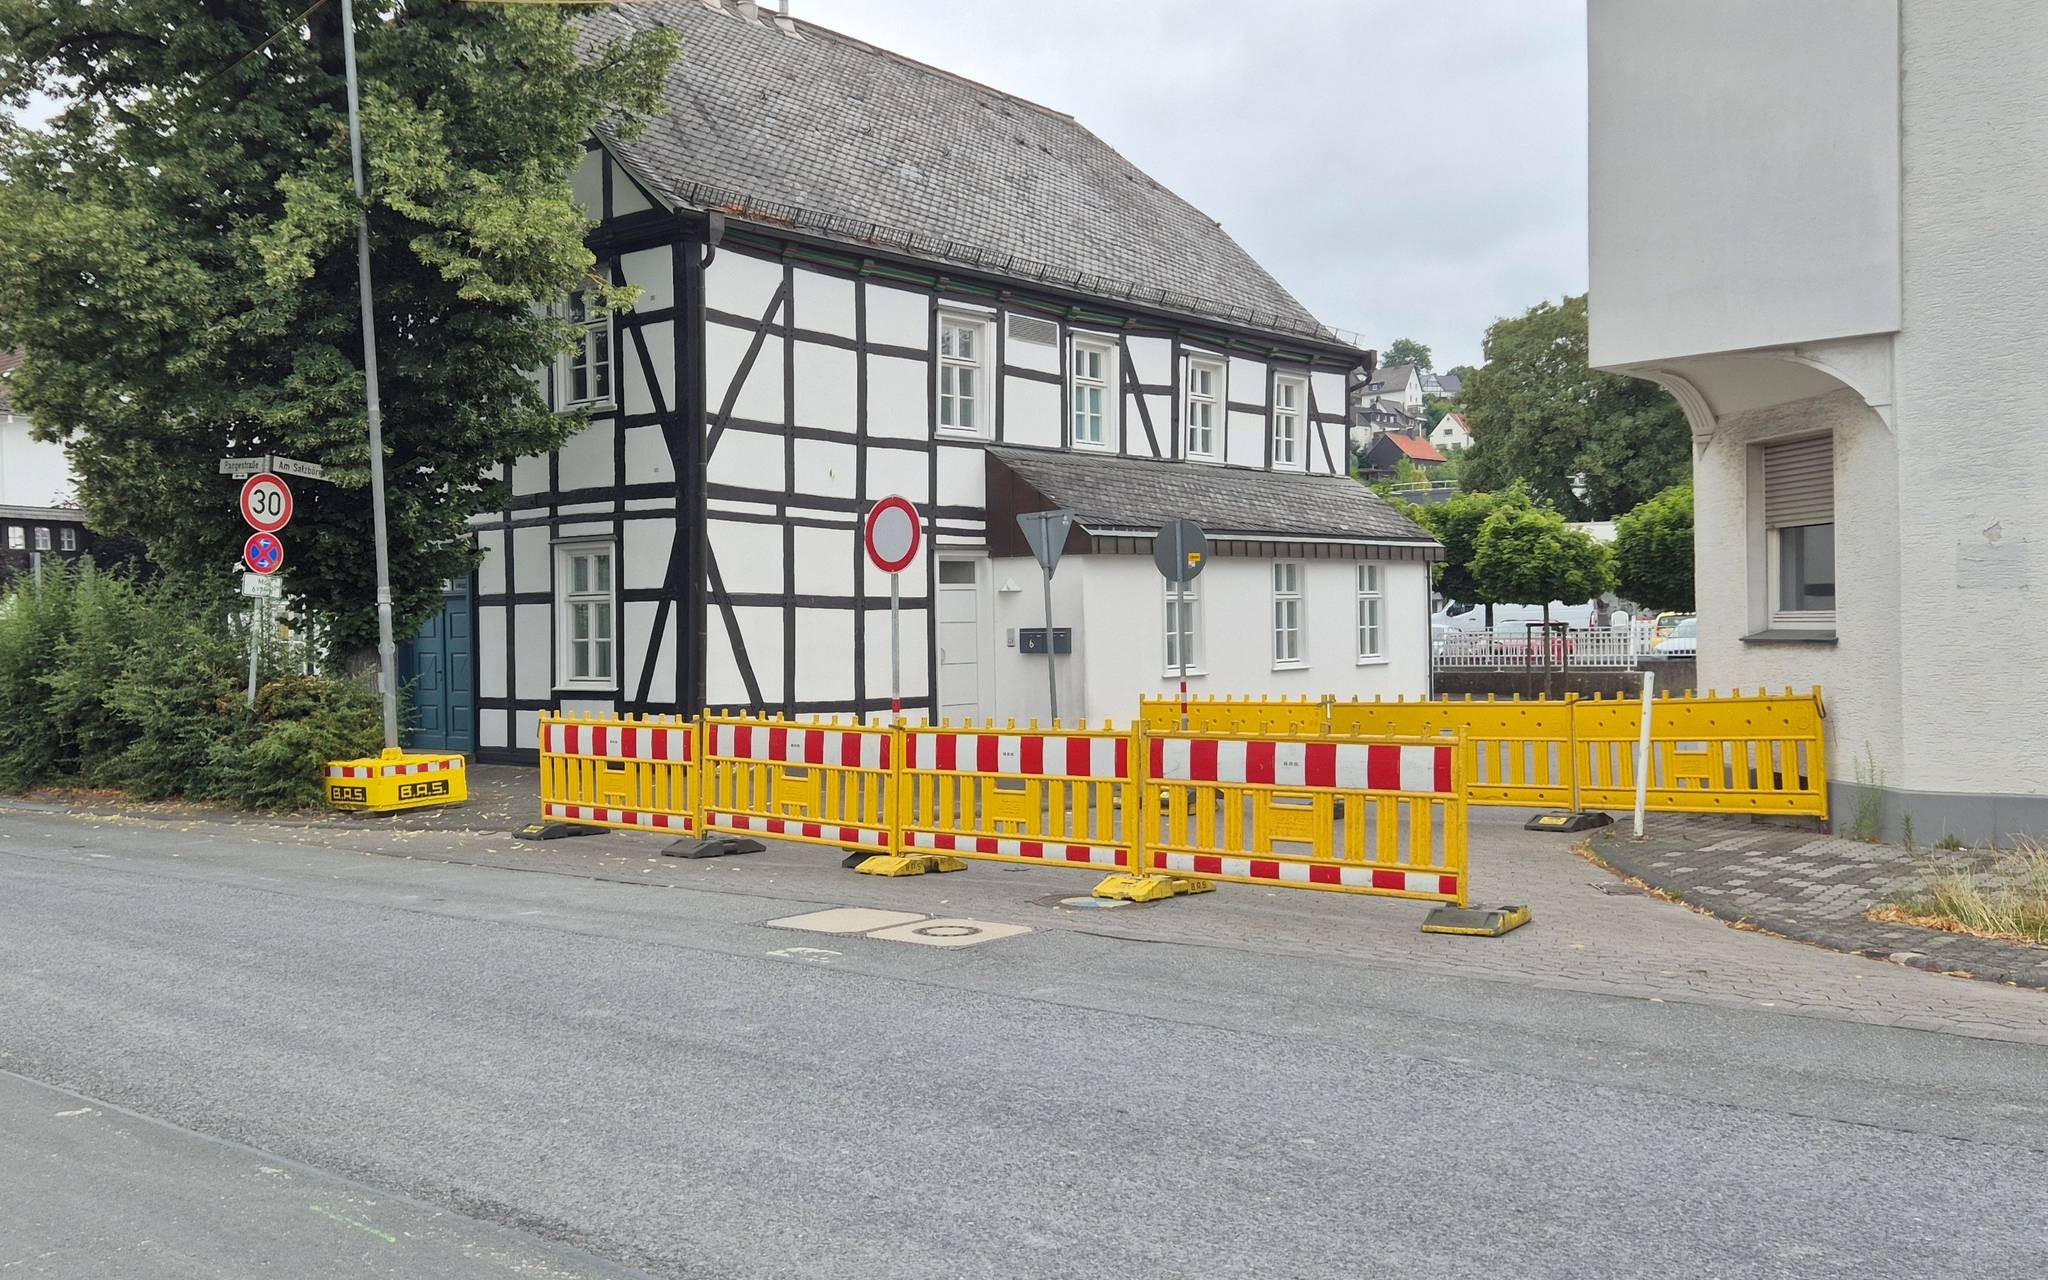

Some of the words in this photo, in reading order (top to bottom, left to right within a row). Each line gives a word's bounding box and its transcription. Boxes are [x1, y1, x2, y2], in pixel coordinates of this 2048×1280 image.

[278, 461, 290, 471] Am
[252, 489, 281, 516] 30
[333, 787, 365, 801] B.A.S.
[401, 782, 447, 798] B.A.S.
